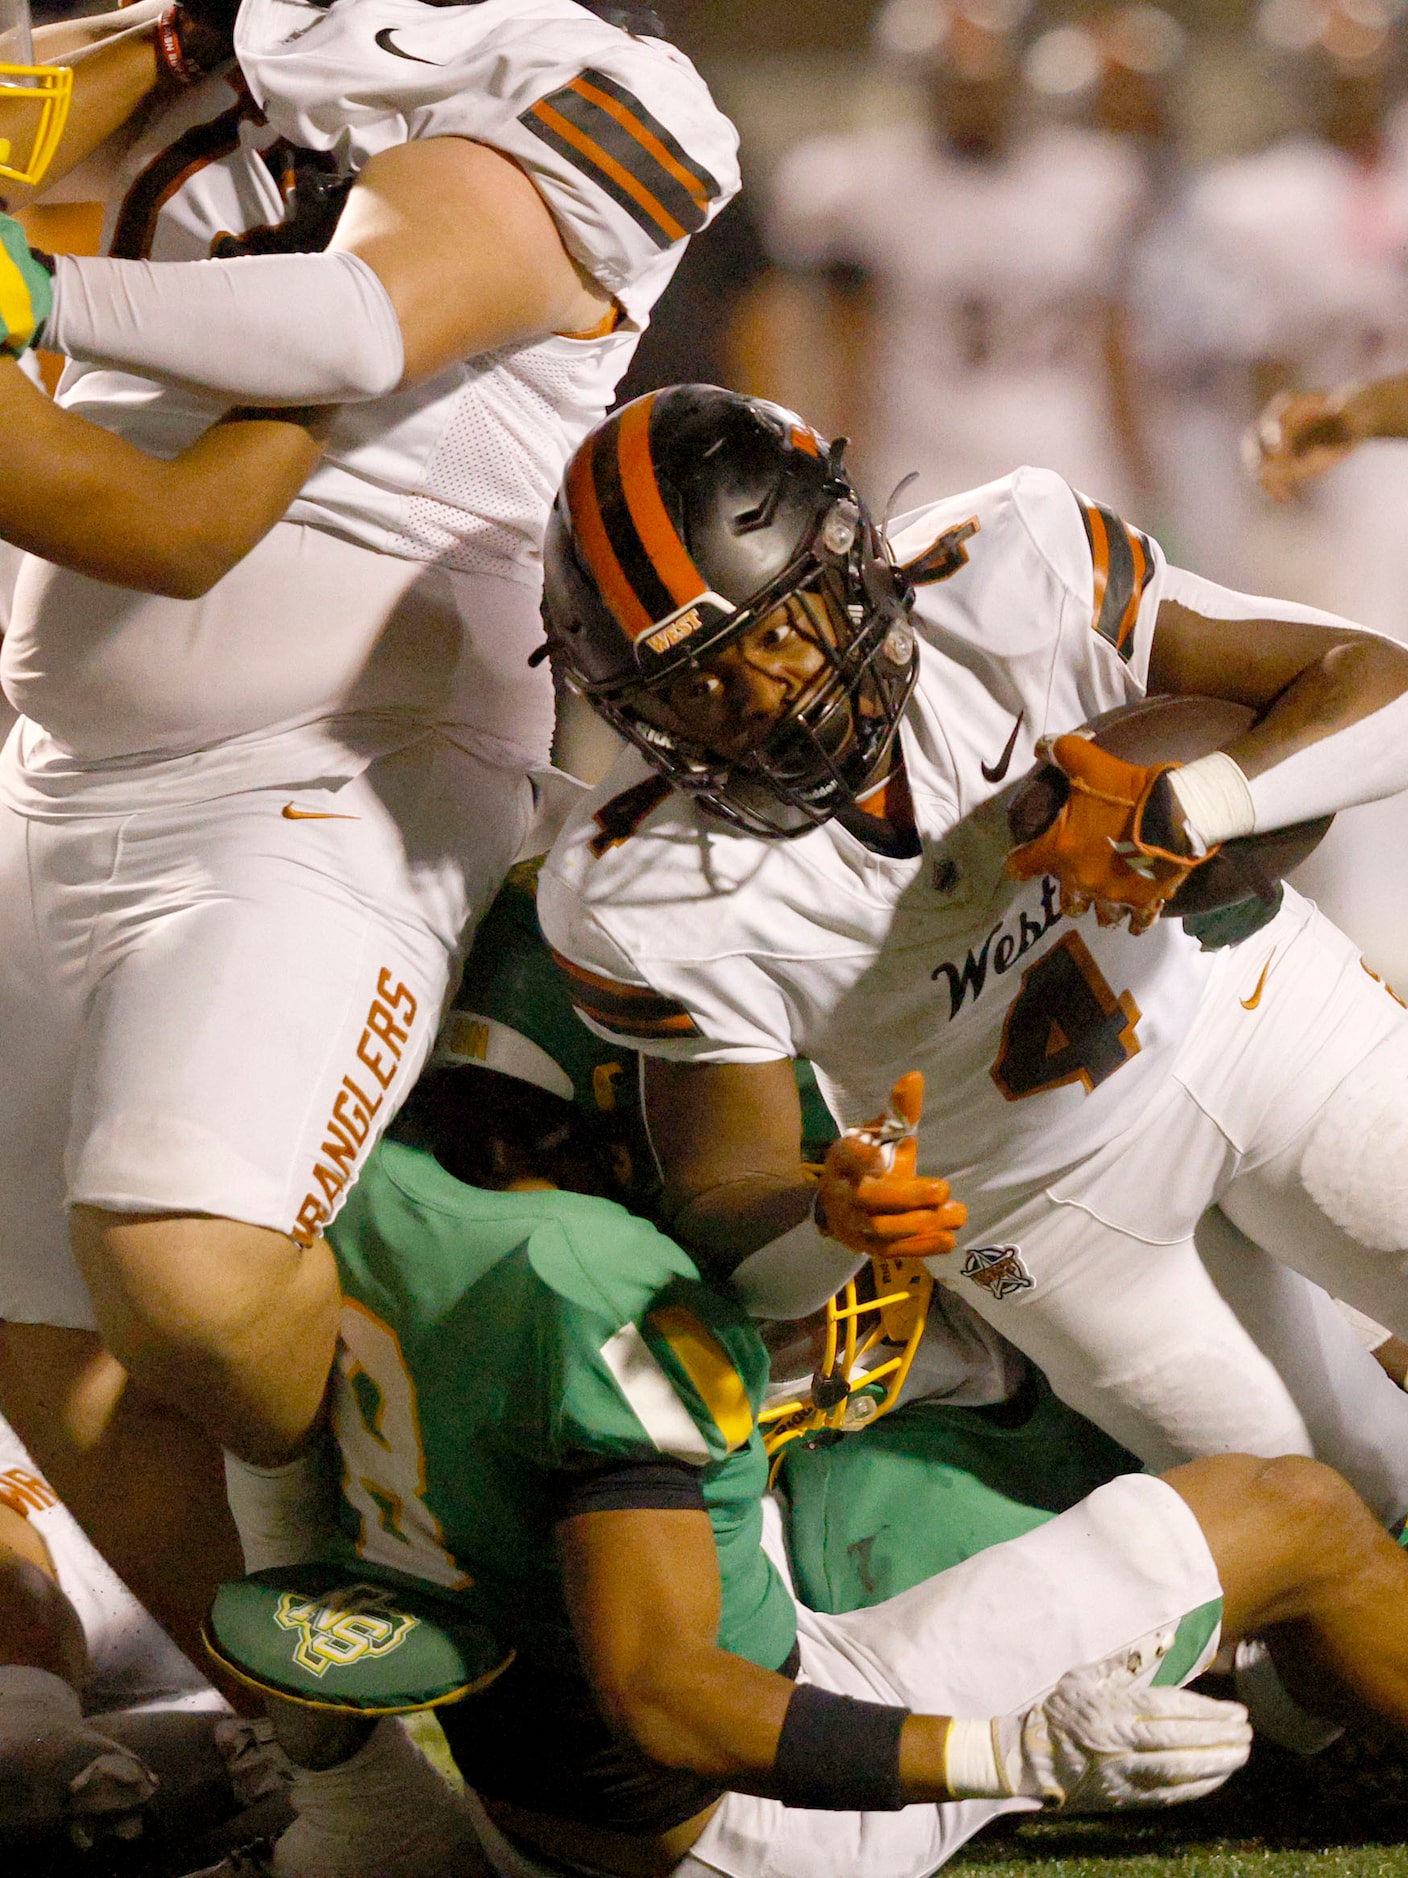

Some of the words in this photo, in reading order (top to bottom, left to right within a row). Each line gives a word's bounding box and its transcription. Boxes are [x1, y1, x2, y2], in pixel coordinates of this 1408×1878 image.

[646, 607, 704, 654] WEST
[930, 873, 1064, 1022] West
[988, 929, 1143, 1102] 4
